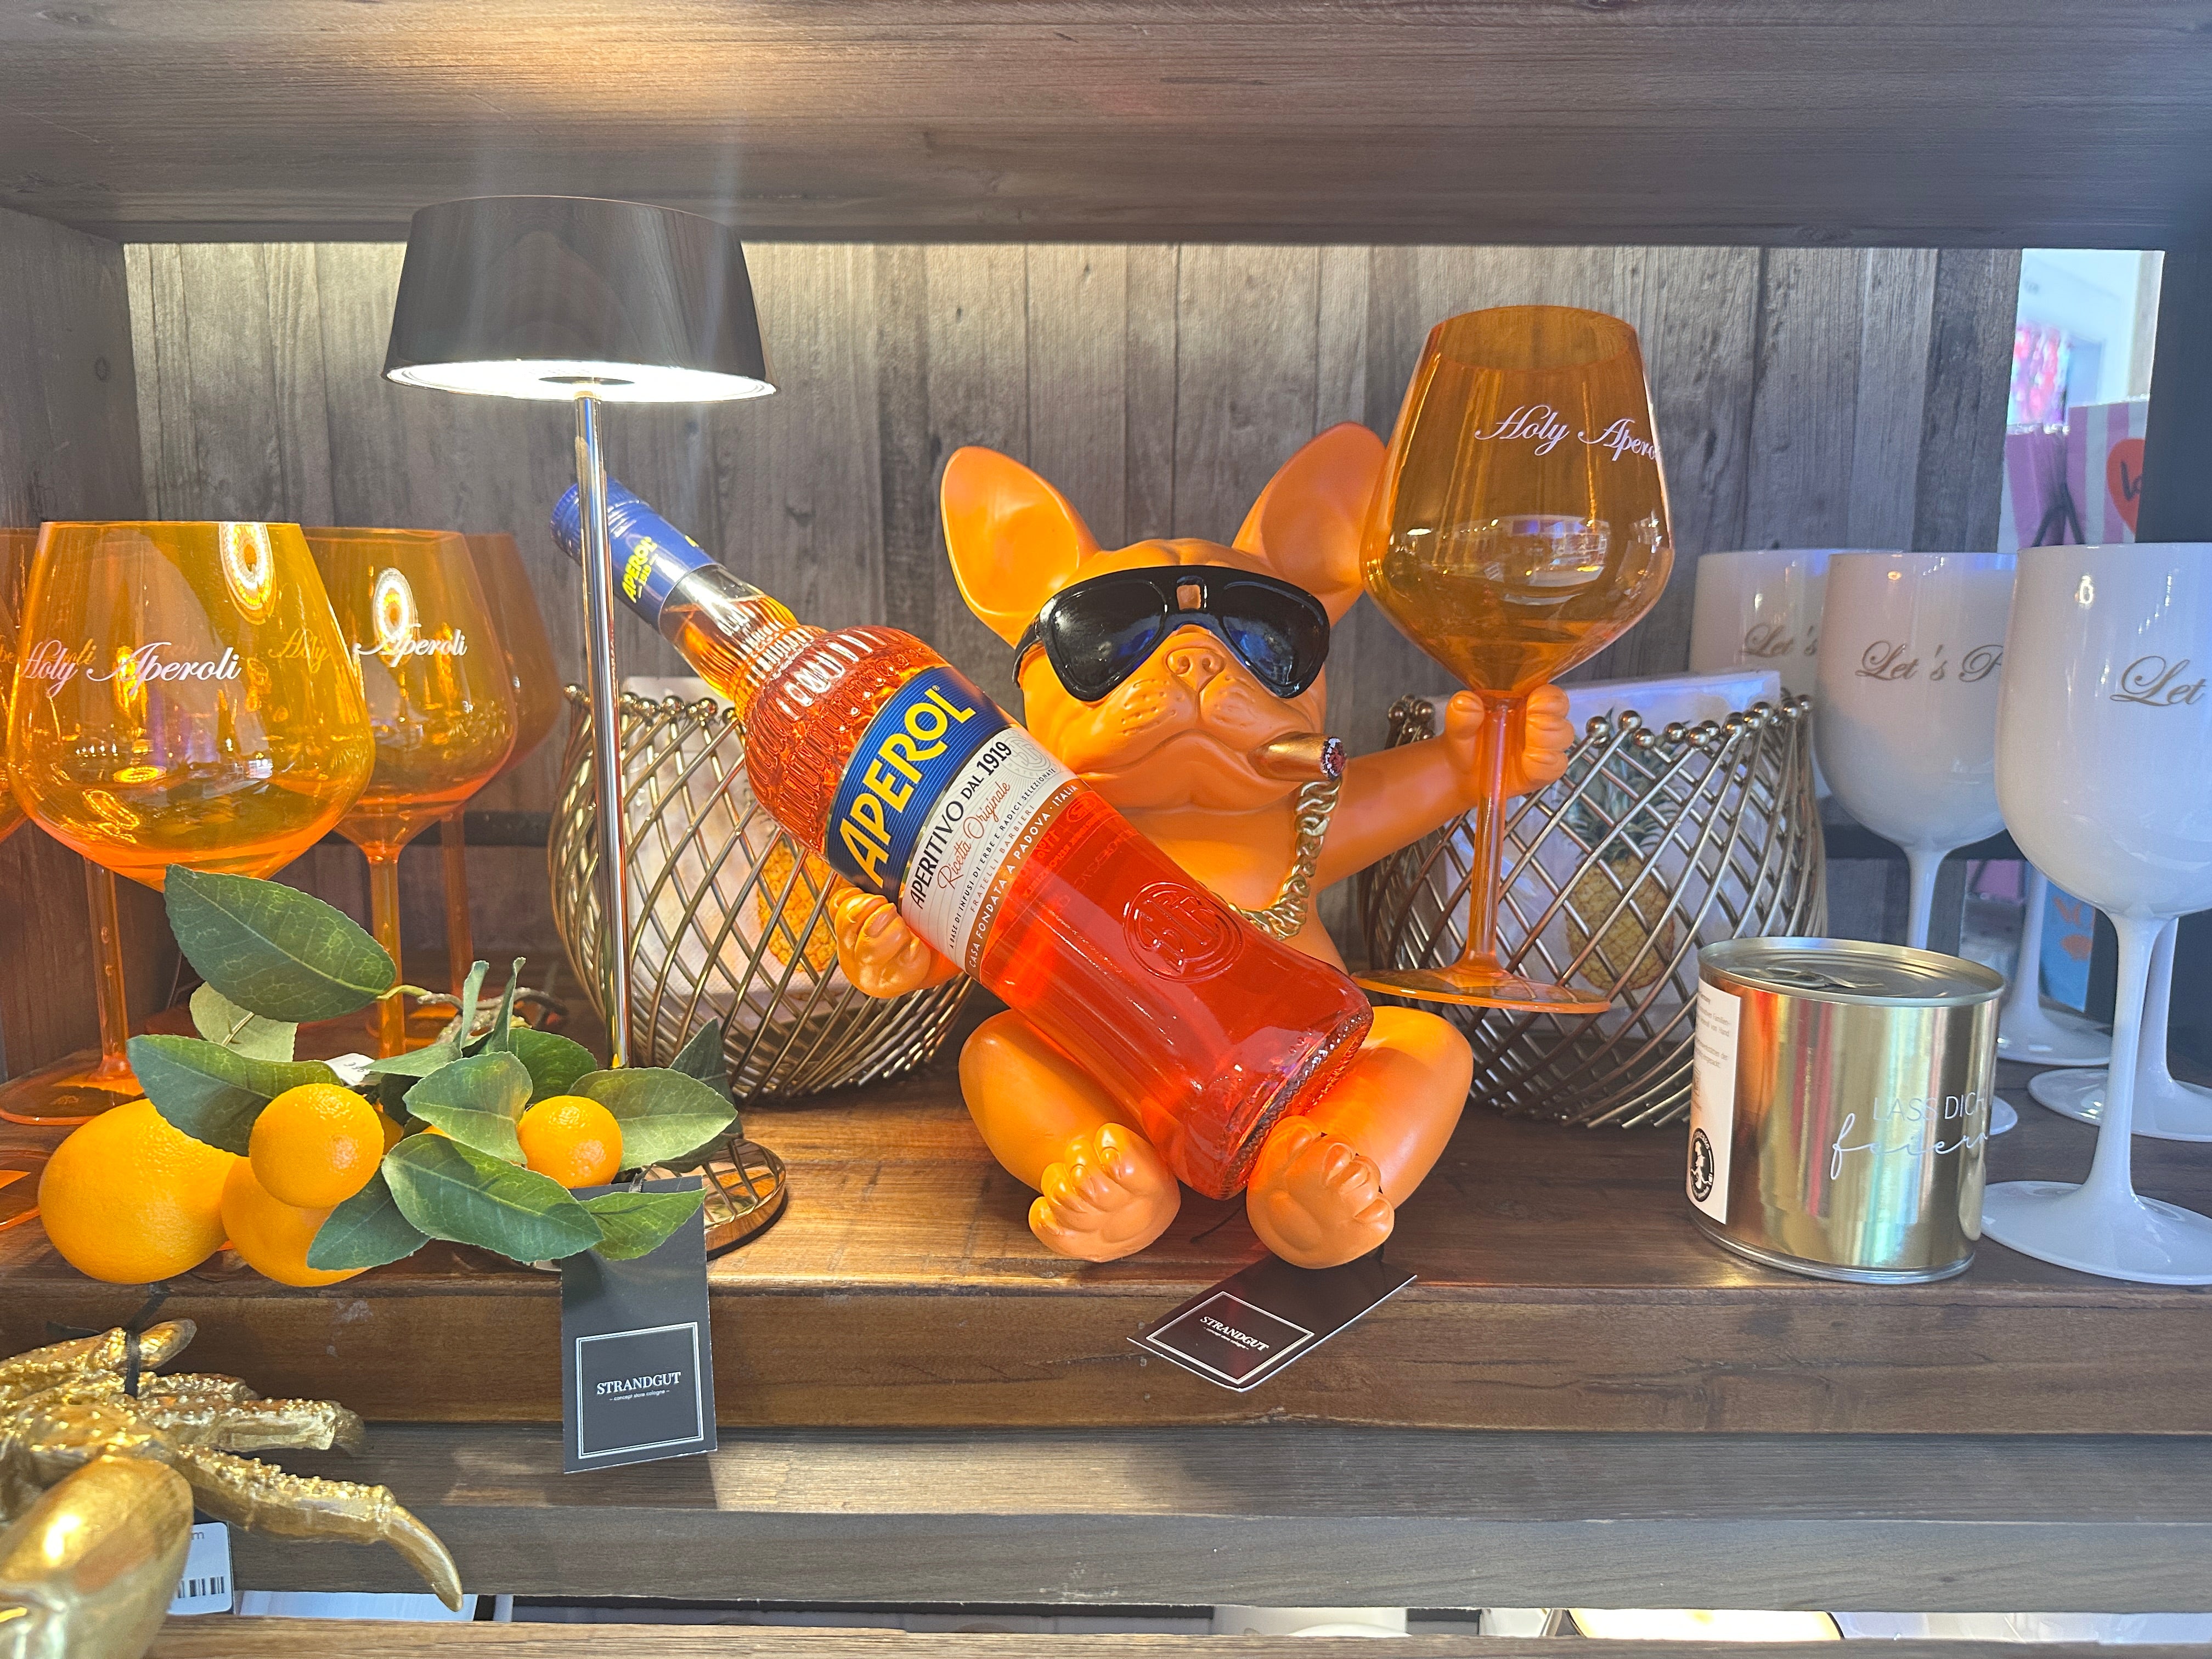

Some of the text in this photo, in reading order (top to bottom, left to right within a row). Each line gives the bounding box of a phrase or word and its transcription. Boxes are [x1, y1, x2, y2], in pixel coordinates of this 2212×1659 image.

[1474, 405, 1570, 456] Holy
[622, 537, 657, 603] APEROL
[20, 640, 242, 698] Holy Aperoli
[839, 687, 977, 889] APEROL
[911, 800, 964, 909] APERITIVO
[961, 775, 985, 800] DAL
[977, 741, 1012, 776] 1919
[938, 840, 972, 890] Ricetta
[963, 781, 1010, 839] Originale
[950, 924, 958, 943] BASE
[955, 913, 962, 923] DI
[959, 881, 974, 911] INFUSI
[973, 866, 981, 878] DI
[980, 840, 995, 864] ERBE
[999, 802, 1022, 831] RADICI
[969, 943, 980, 967] CASA
[975, 879, 1007, 939] FONDATA
[1006, 865, 1015, 874] A
[1013, 812, 1051, 860] PADOVA
[1052, 785, 1079, 806] ITALIA
[970, 859, 998, 913] FRATELLI
[999, 805, 1035, 854] BARBIERI
[1873, 1097, 1937, 1121] LASS
[1200, 1316, 1269, 1351] STRANDGUT
[596, 1371, 681, 1395] STRANDGUT
